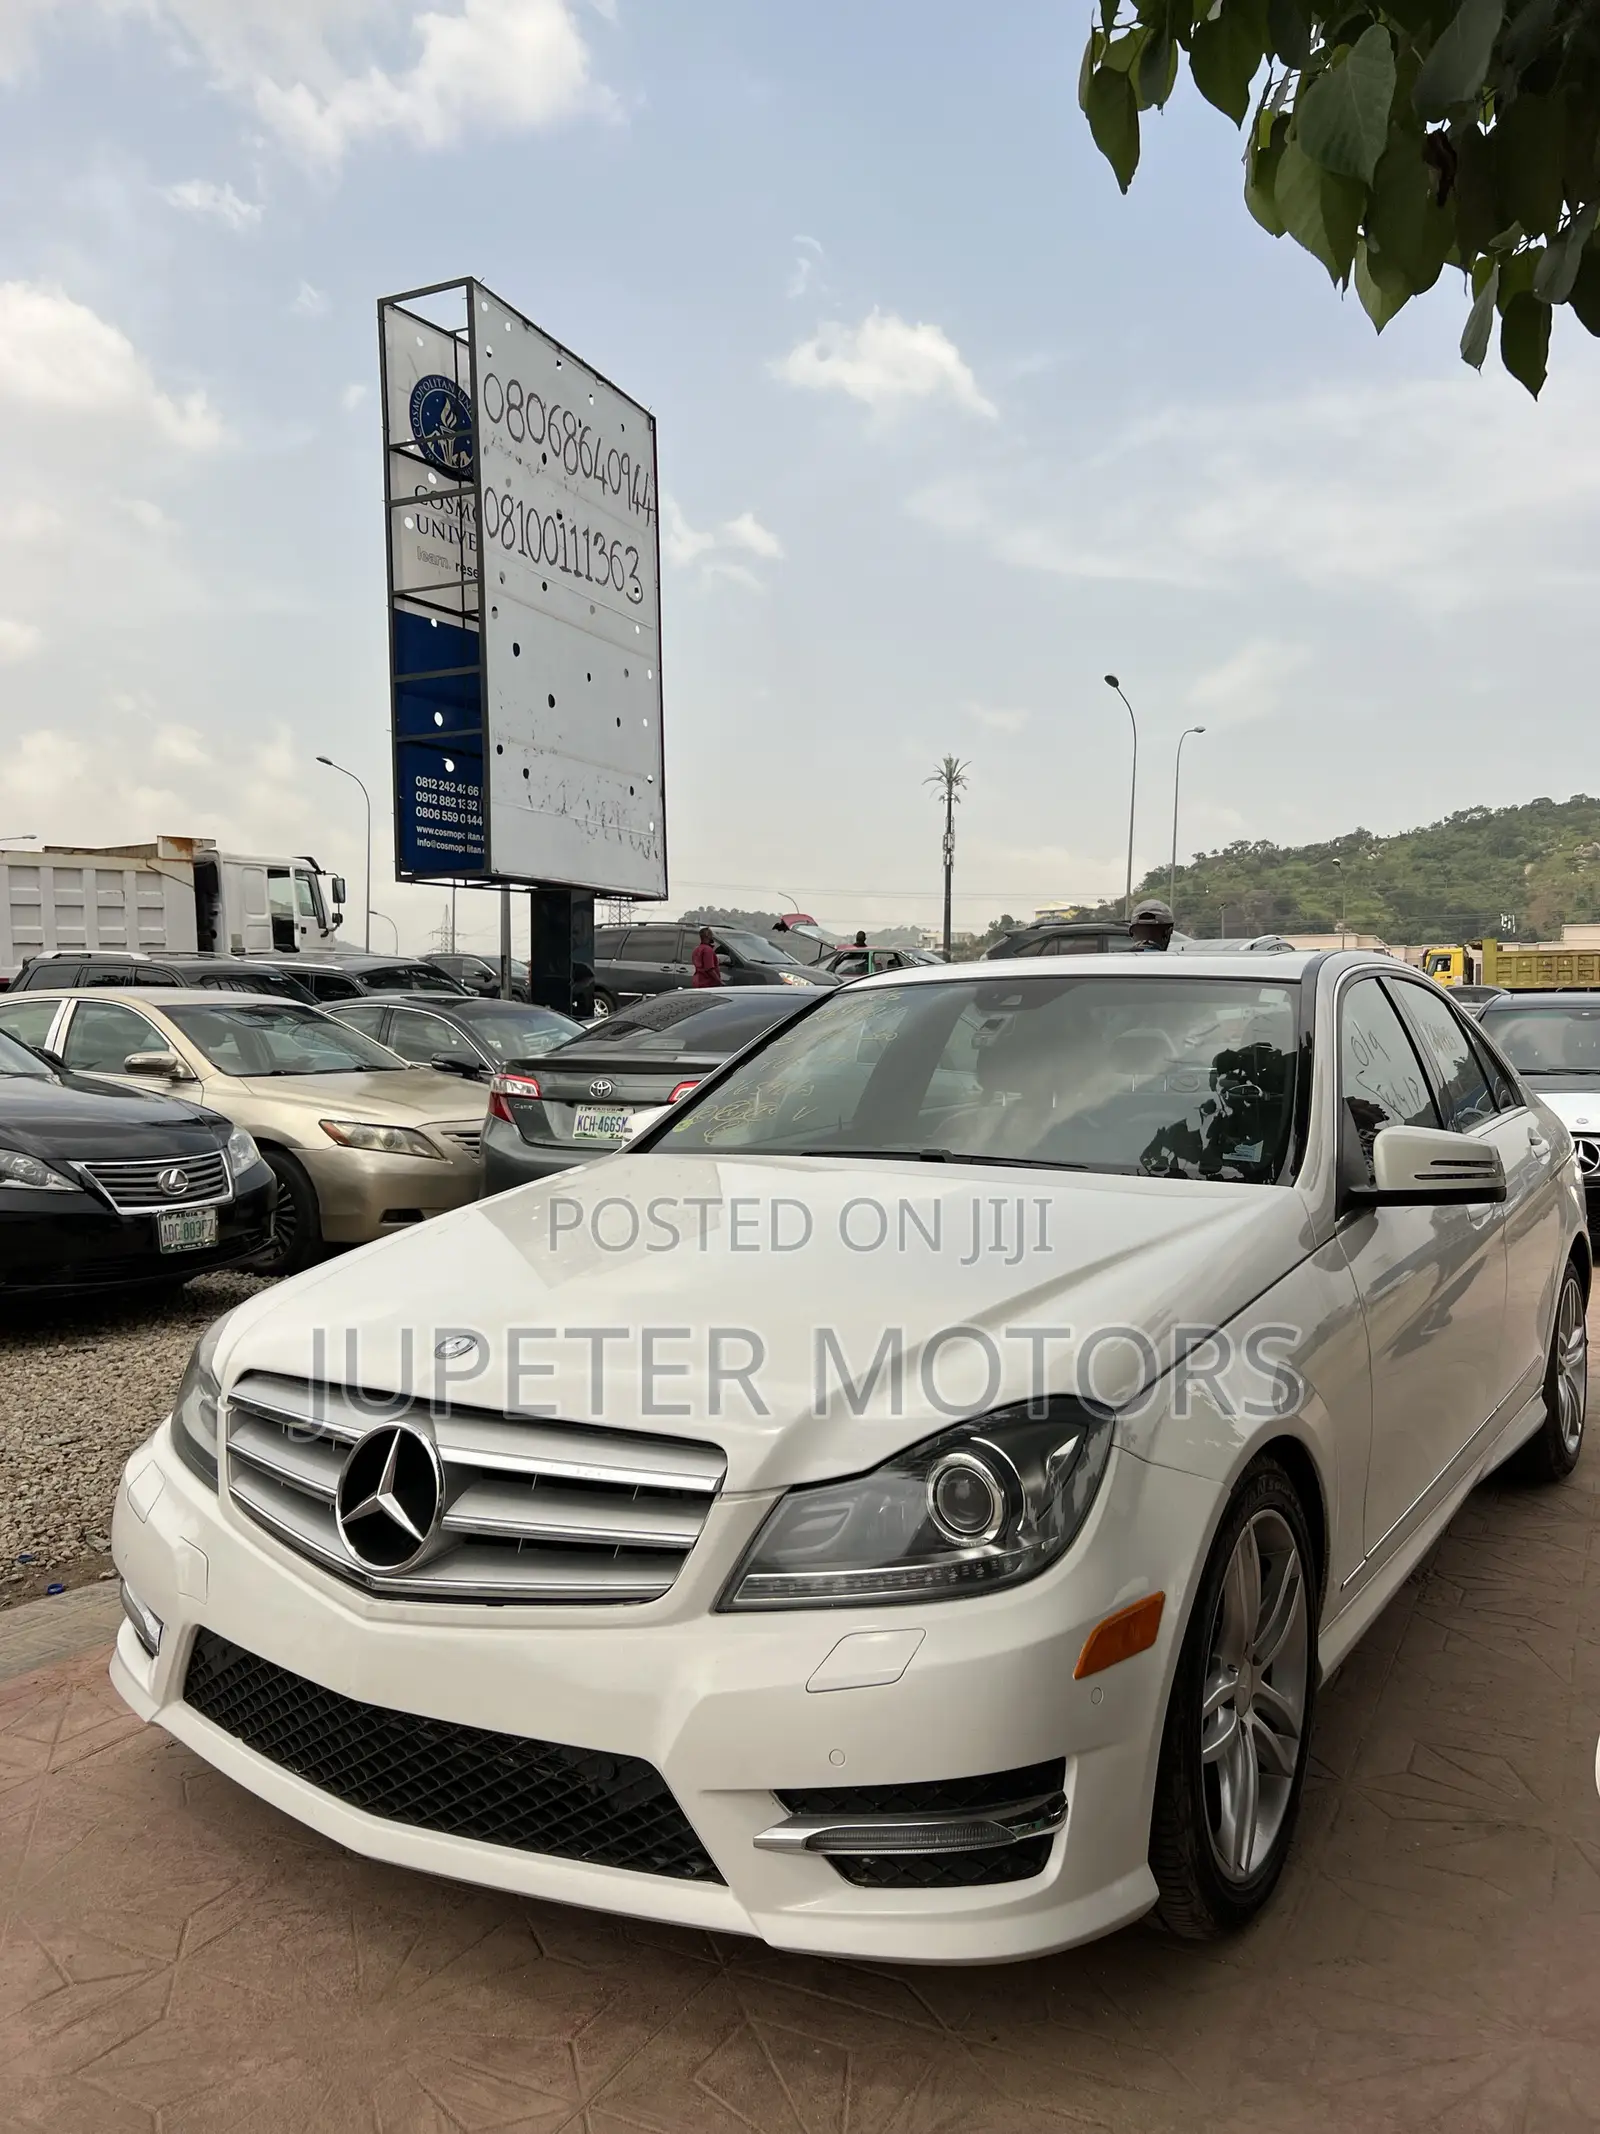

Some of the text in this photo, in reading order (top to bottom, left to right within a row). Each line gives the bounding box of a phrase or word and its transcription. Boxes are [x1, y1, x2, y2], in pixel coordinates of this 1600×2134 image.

[484, 373, 655, 526] 08068640944
[415, 484, 476, 524] COSM
[484, 486, 643, 604] 08100111363
[415, 775, 438, 790] 0812
[438, 780, 456, 793] 242
[415, 791, 438, 805] 0912
[439, 795, 457, 808] 882
[415, 806, 441, 820] 0806
[441, 810, 459, 823] 559
